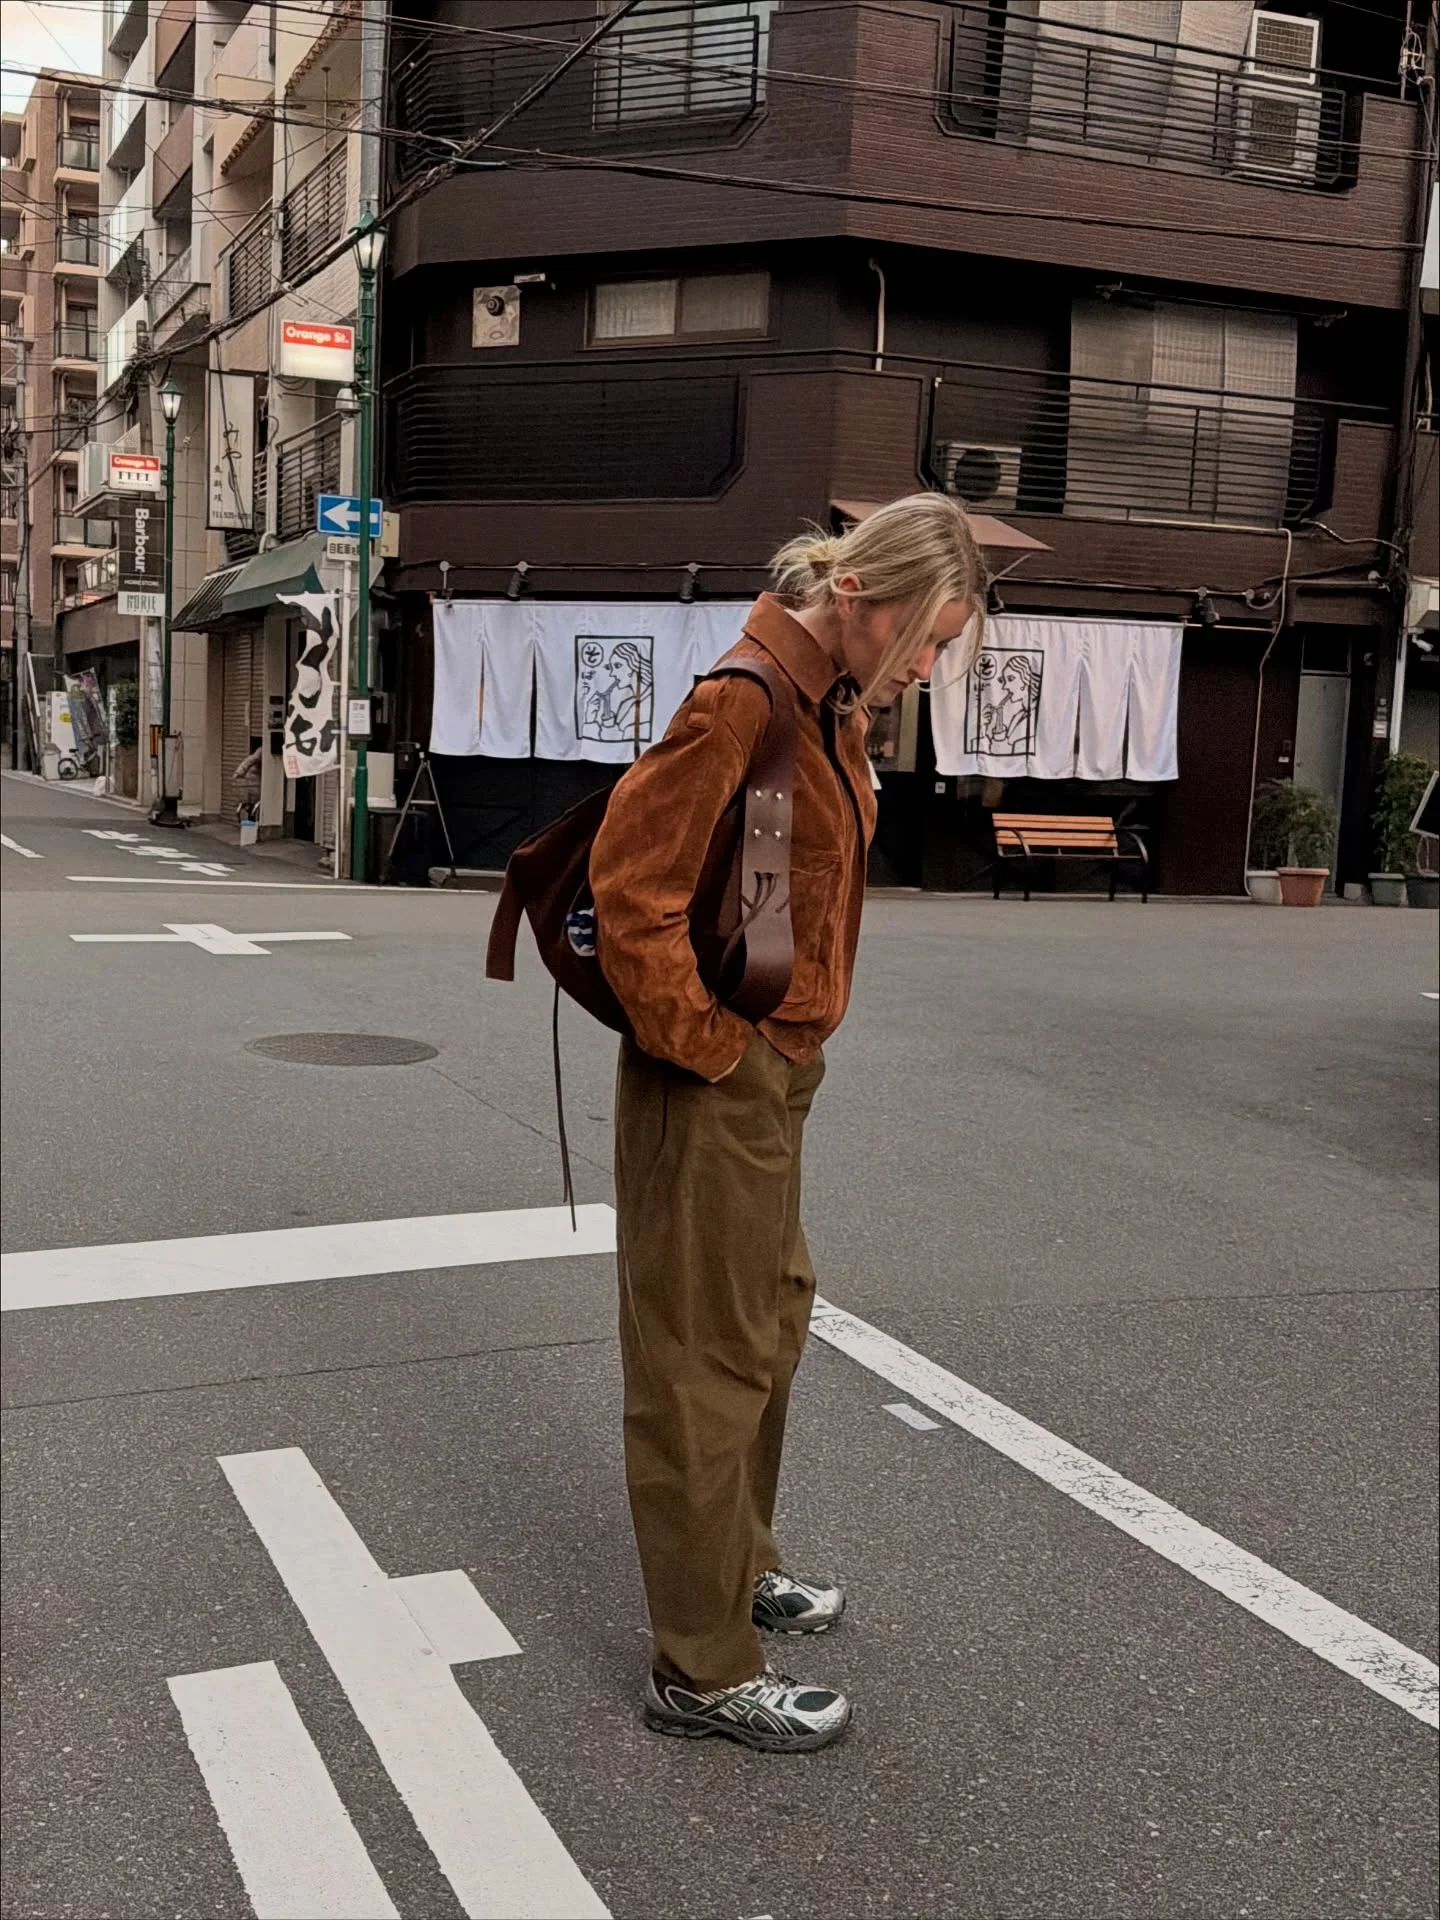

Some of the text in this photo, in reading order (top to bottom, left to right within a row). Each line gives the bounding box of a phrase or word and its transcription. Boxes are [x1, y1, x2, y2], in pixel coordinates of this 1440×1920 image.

[286, 326, 350, 344] Orange St.
[135, 508, 150, 573] Barbour
